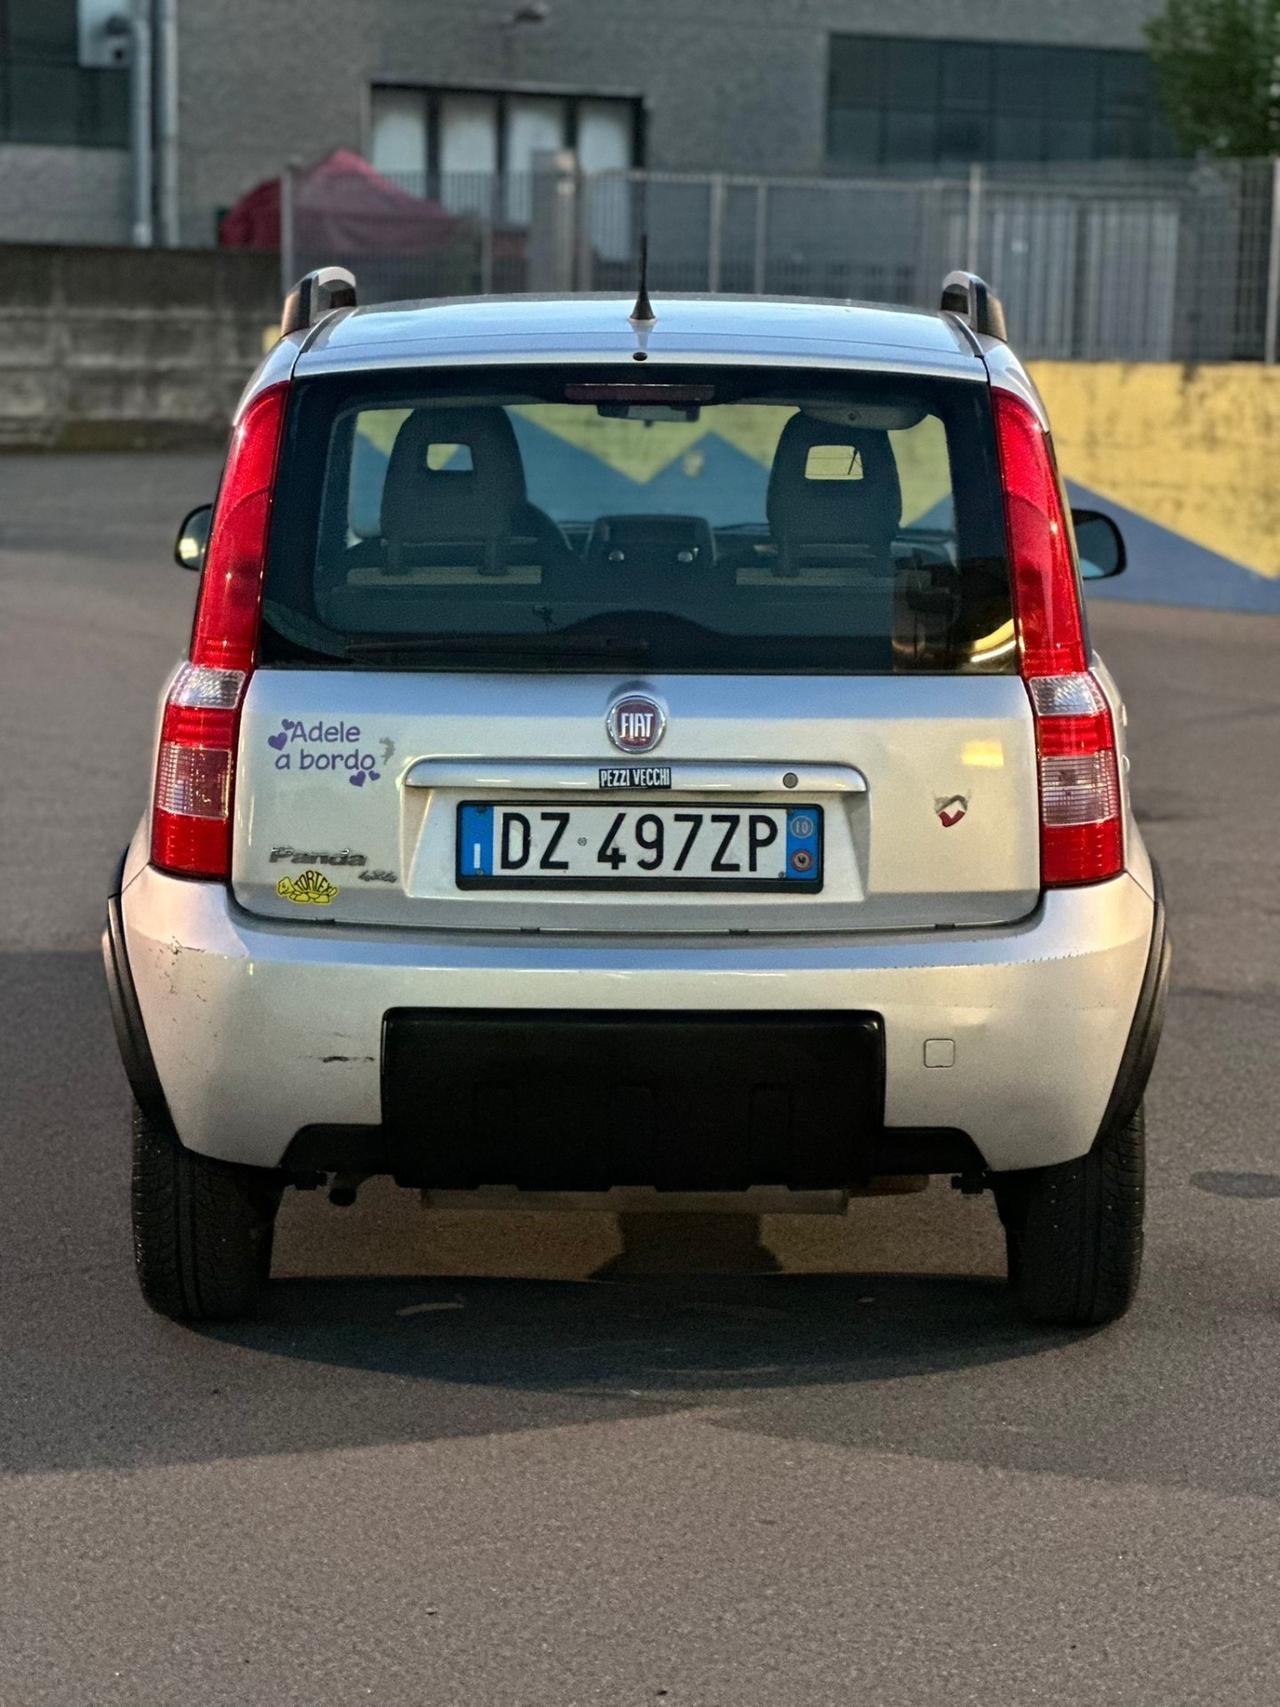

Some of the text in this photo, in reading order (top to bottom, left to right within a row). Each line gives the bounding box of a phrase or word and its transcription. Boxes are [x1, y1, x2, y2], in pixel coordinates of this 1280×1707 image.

[290, 721, 360, 743] Adele
[619, 713, 654, 738] FIAT
[275, 749, 376, 770] a bordo
[600, 768, 671, 787] PEZZI VECCHI
[269, 847, 367, 866] Panda
